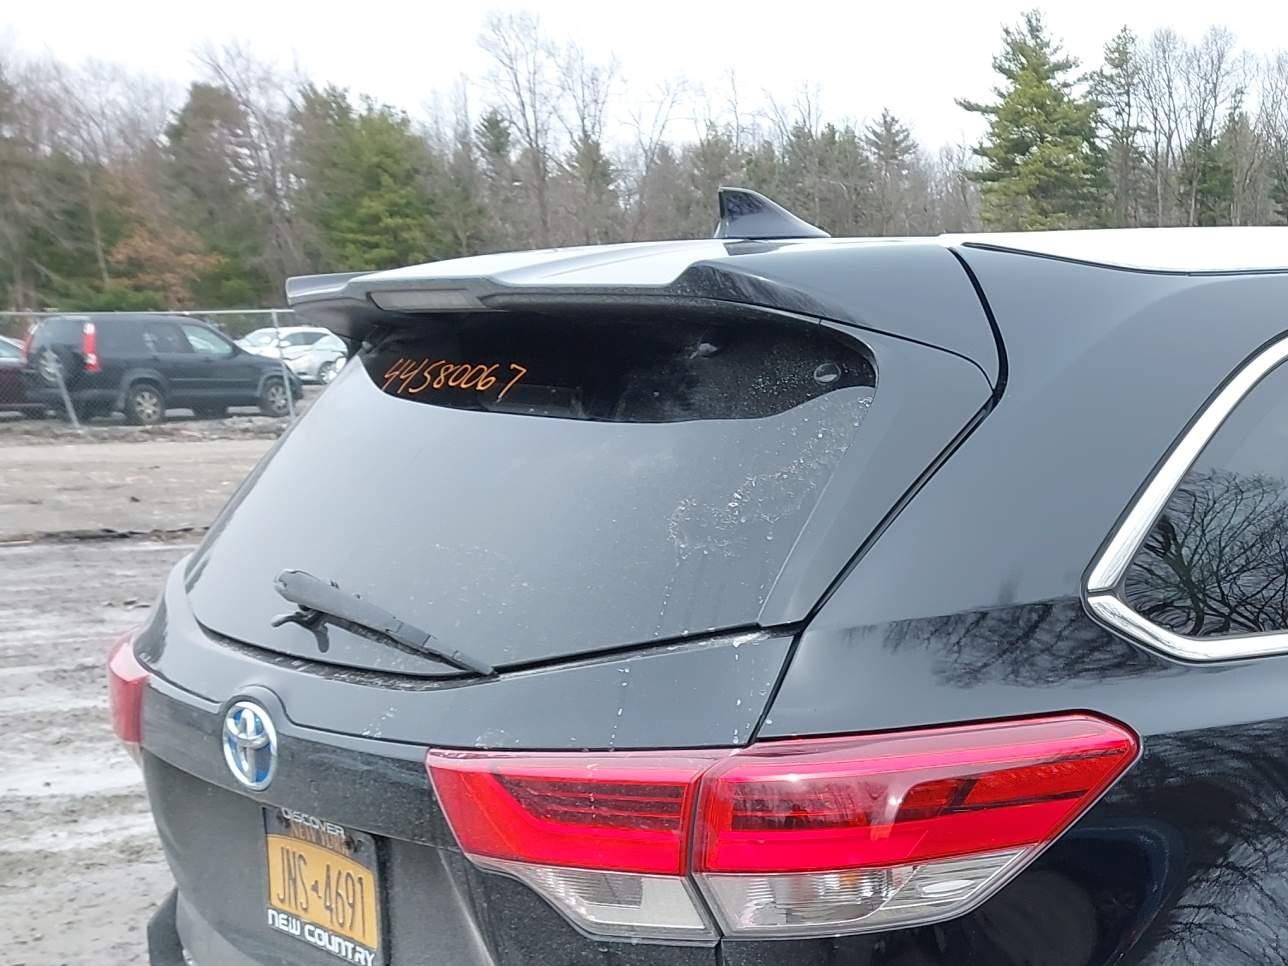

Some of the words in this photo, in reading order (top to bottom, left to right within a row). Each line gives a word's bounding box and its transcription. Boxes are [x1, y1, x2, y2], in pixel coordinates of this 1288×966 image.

[382, 358, 527, 402] 44580067
[281, 807, 345, 837] DISCOVER
[268, 909, 301, 936] NEW
